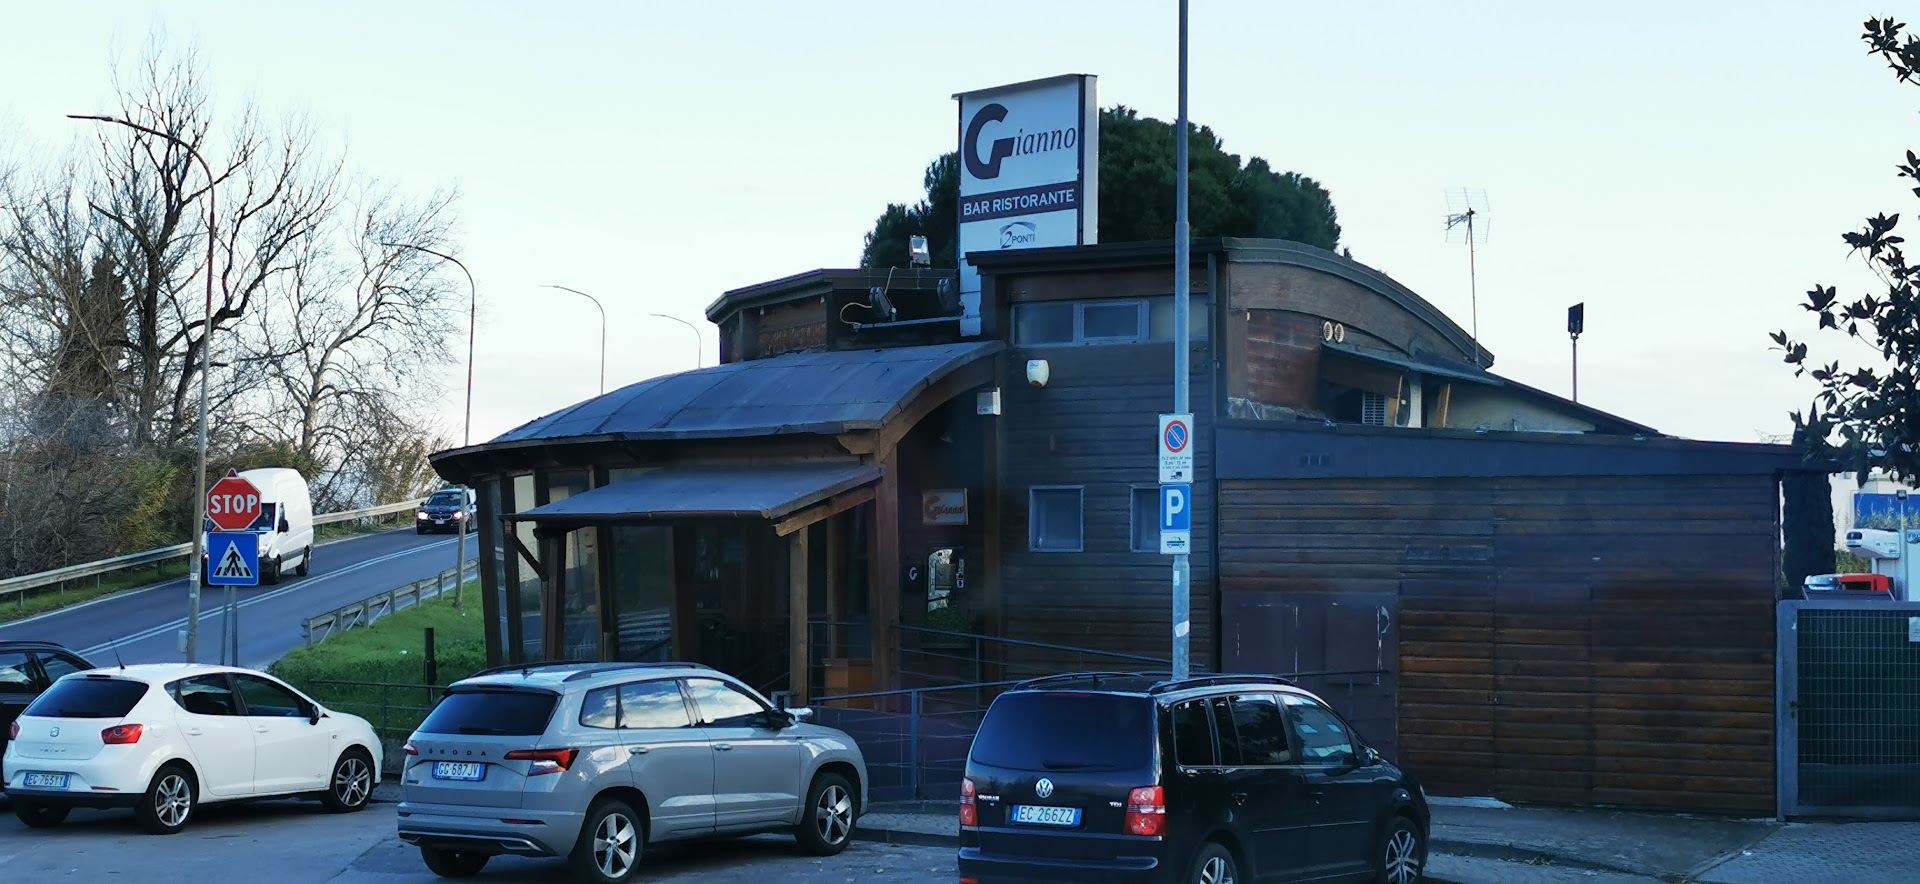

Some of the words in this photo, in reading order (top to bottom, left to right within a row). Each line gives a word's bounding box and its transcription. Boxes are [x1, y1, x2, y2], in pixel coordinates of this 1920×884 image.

[963, 103, 1077, 180] Gianno
[963, 202, 990, 216] BAR
[992, 189, 1075, 213] RISTORANTE
[1012, 233, 1035, 244] PONTI
[210, 494, 258, 514] STOP
[1166, 489, 1184, 527] P
[1019, 806, 1034, 821] EC
[1037, 807, 1074, 823] 266ZZ
